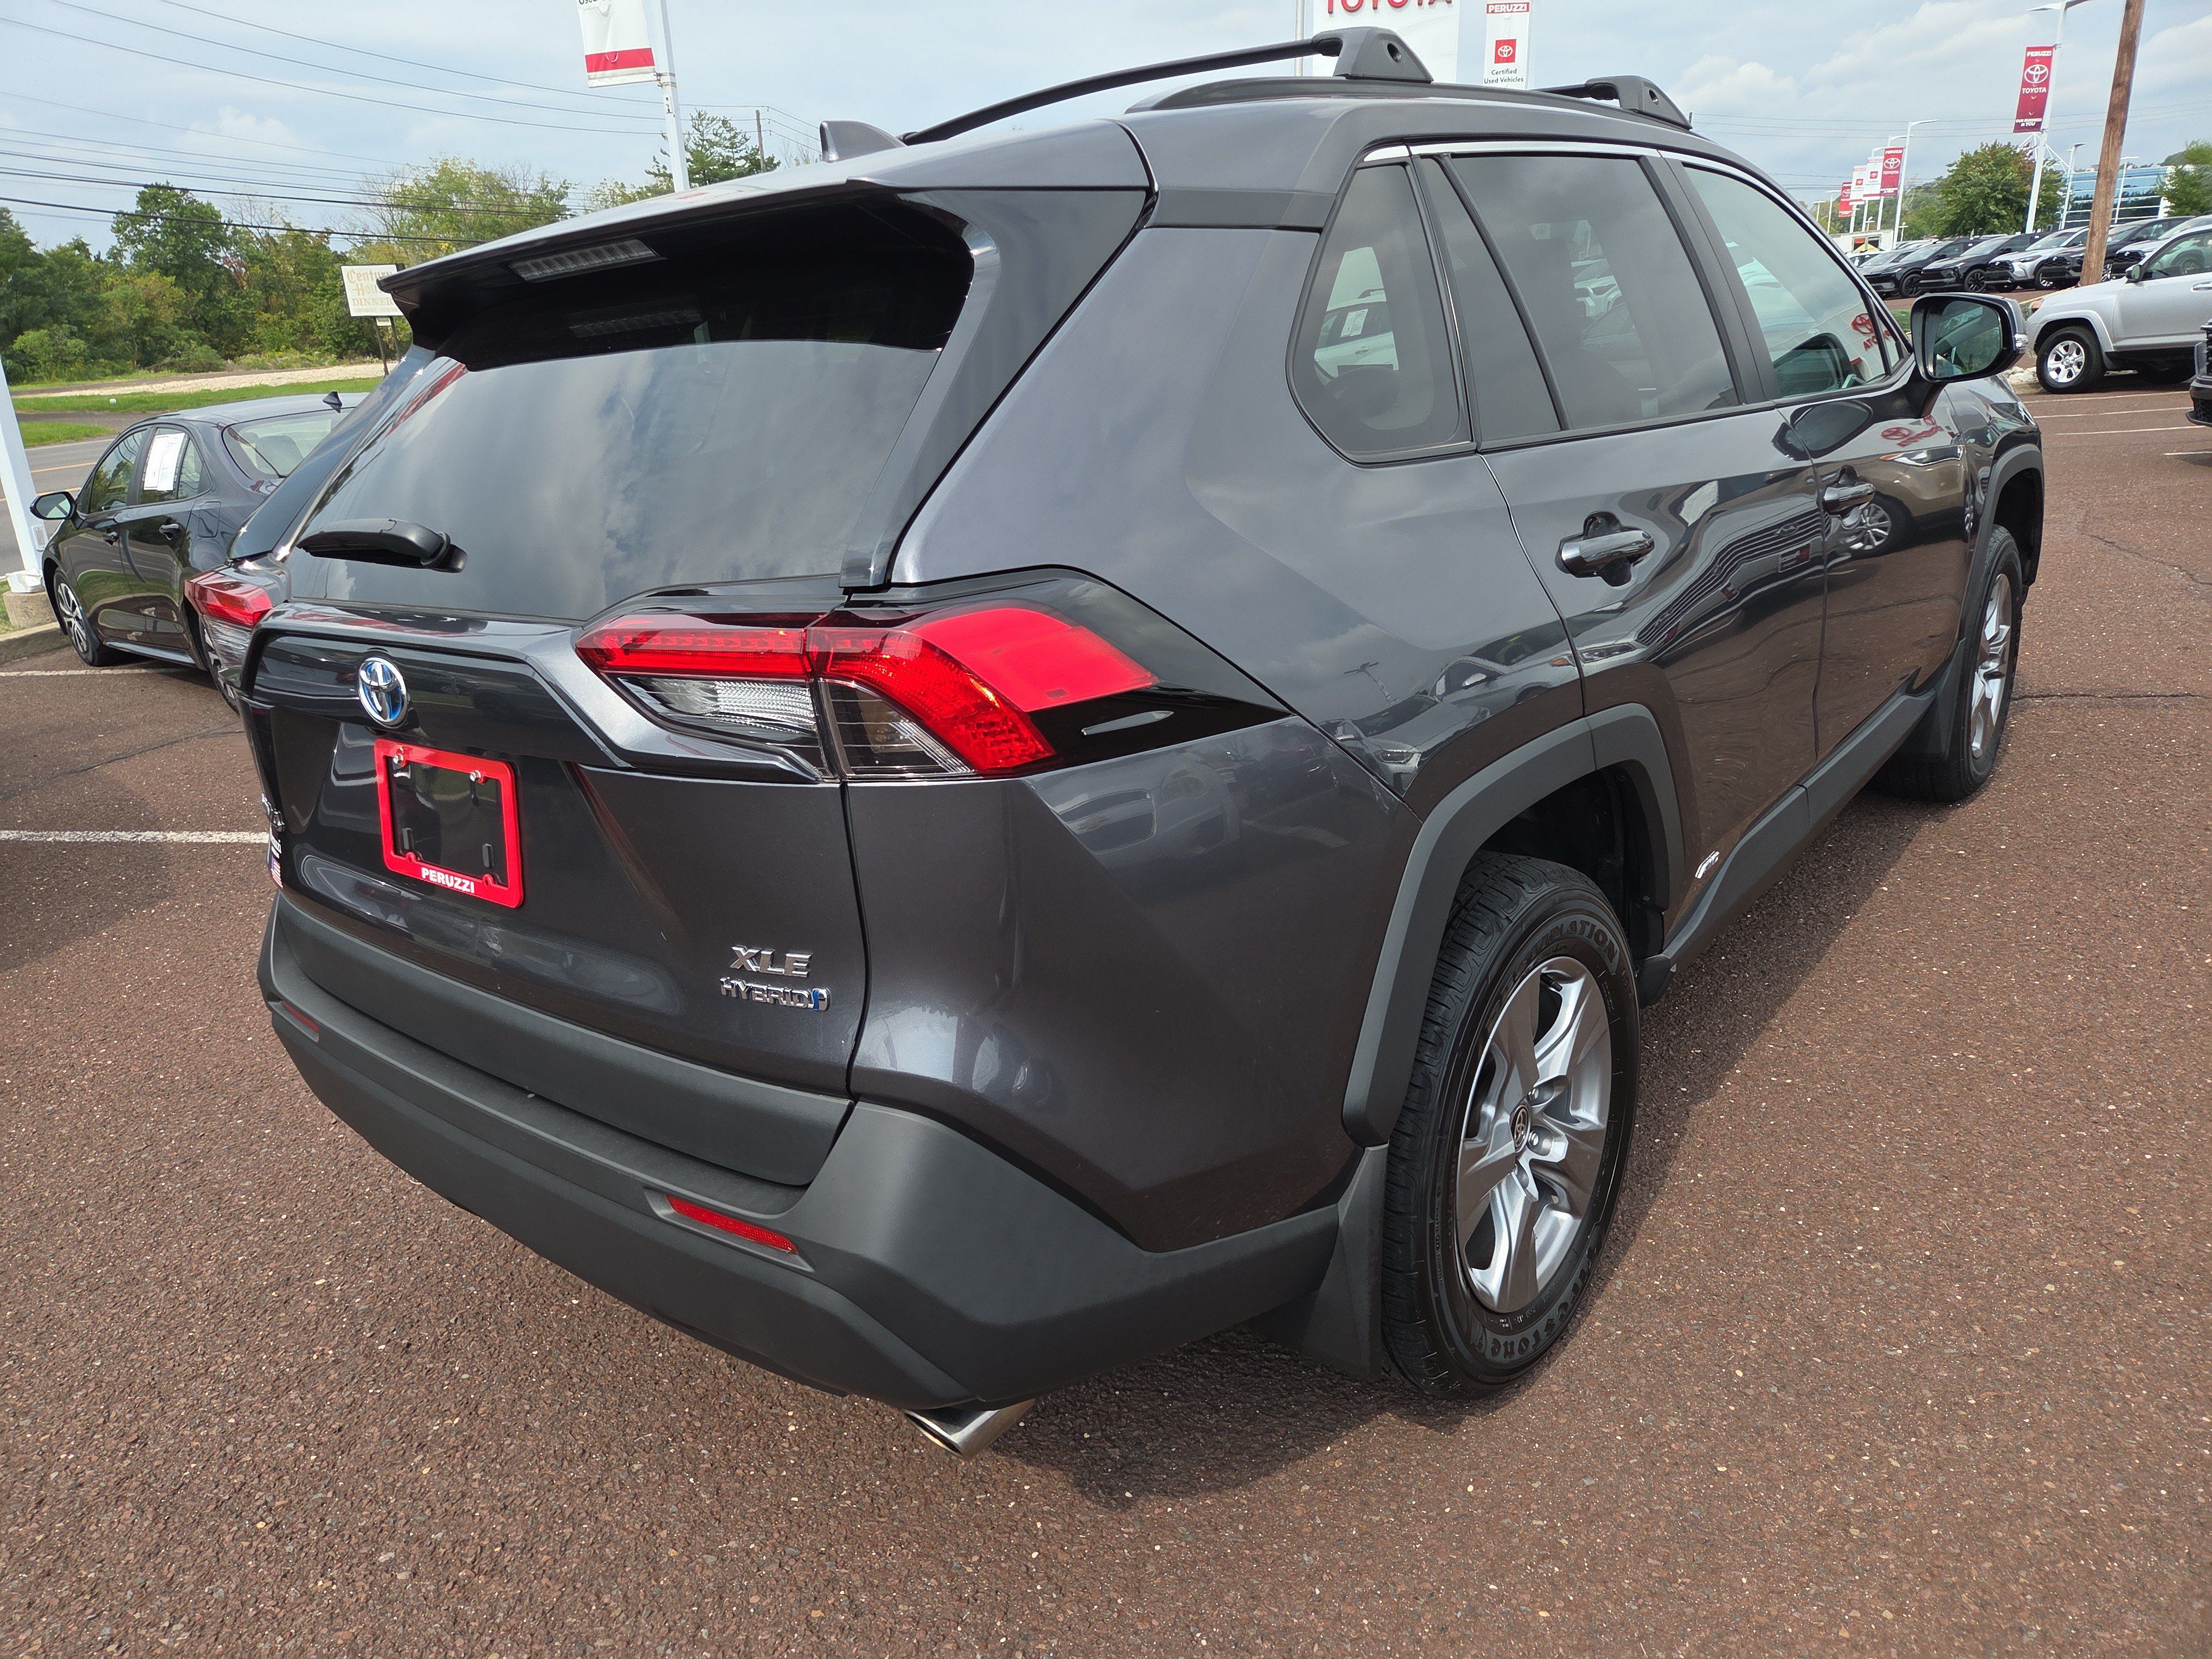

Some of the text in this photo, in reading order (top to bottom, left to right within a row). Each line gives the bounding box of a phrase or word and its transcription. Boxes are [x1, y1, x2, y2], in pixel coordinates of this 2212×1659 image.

[1488, 4, 1527, 13] PERUZZI
[421, 867, 475, 893] PERUZZI
[730, 945, 813, 978] XLE
[720, 976, 812, 1008] HYBRID
